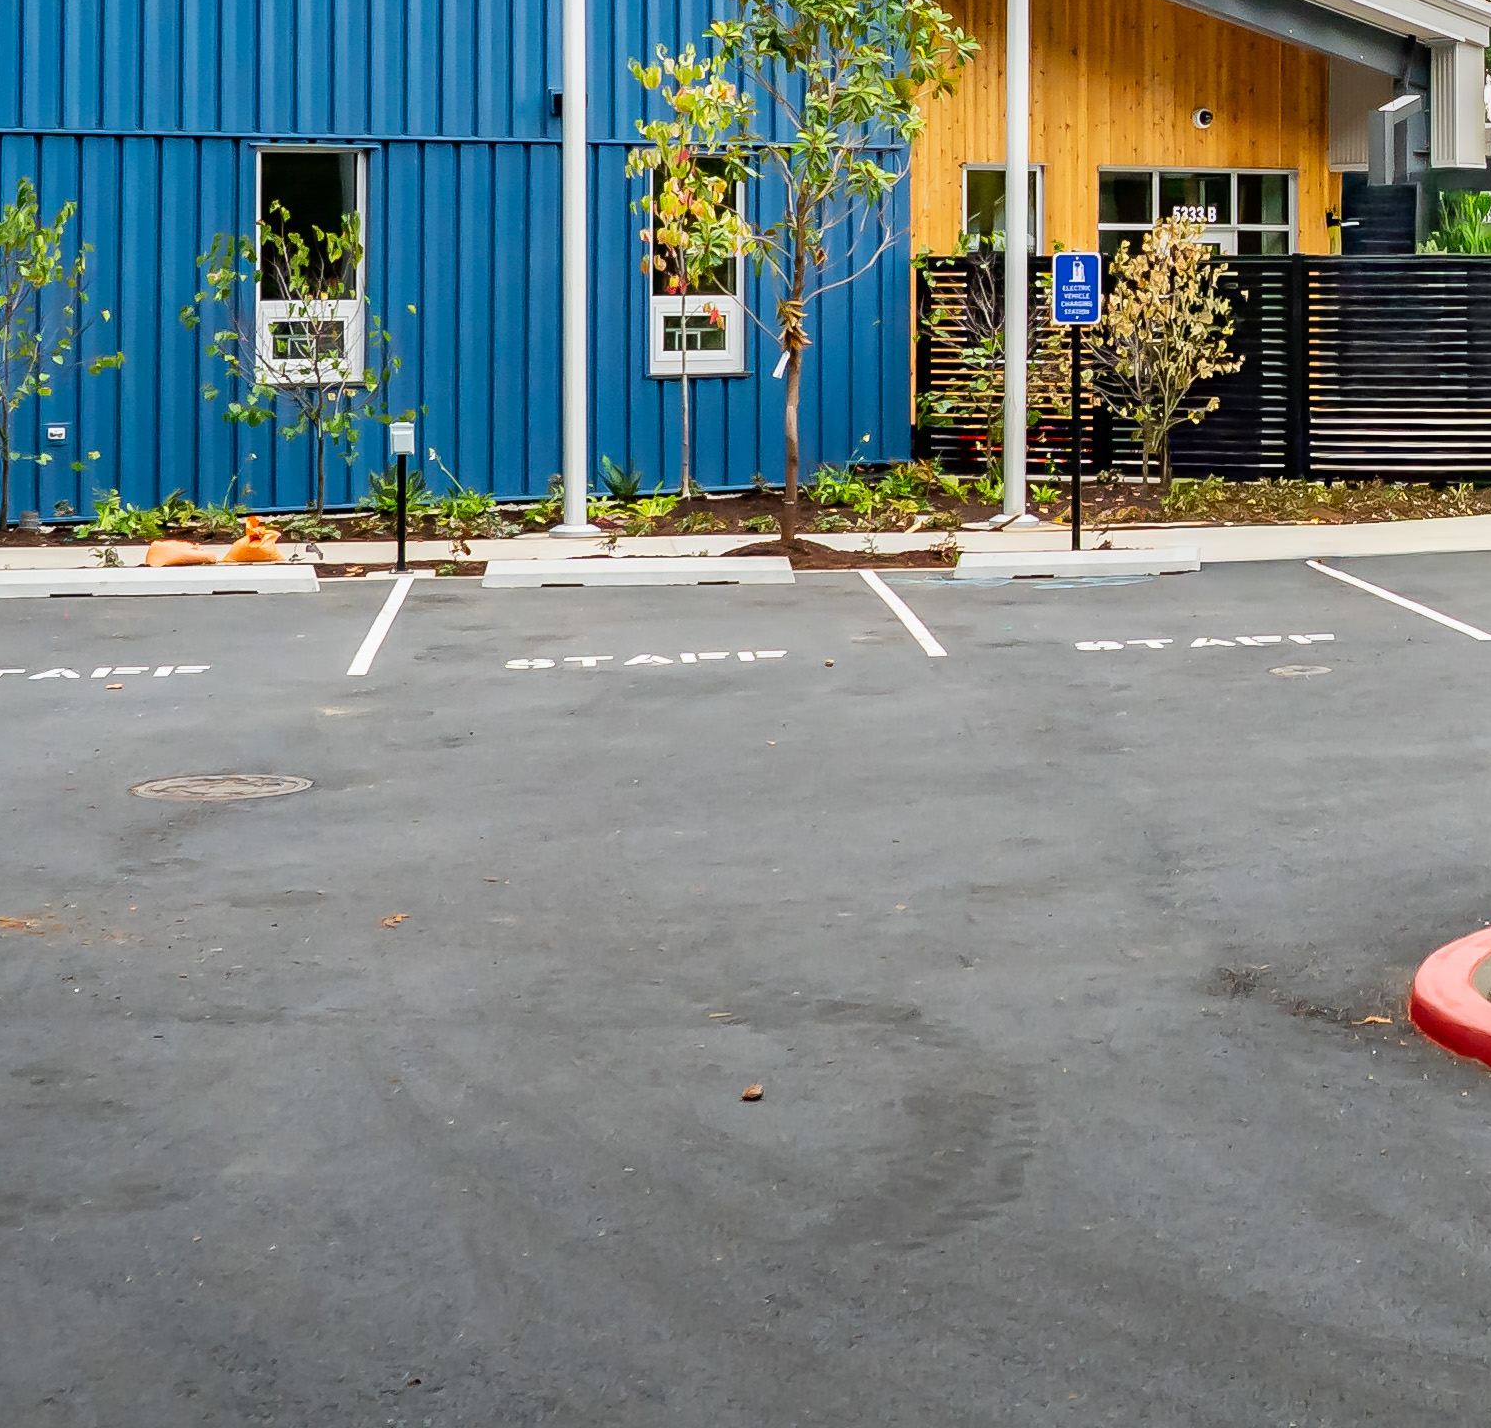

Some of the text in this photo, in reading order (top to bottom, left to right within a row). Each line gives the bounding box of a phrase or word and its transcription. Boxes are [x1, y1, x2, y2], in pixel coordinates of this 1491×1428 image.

[1172, 205, 1217, 223] 5333 B
[1075, 633, 1335, 651] STAFF
[504, 650, 788, 669] STAFF
